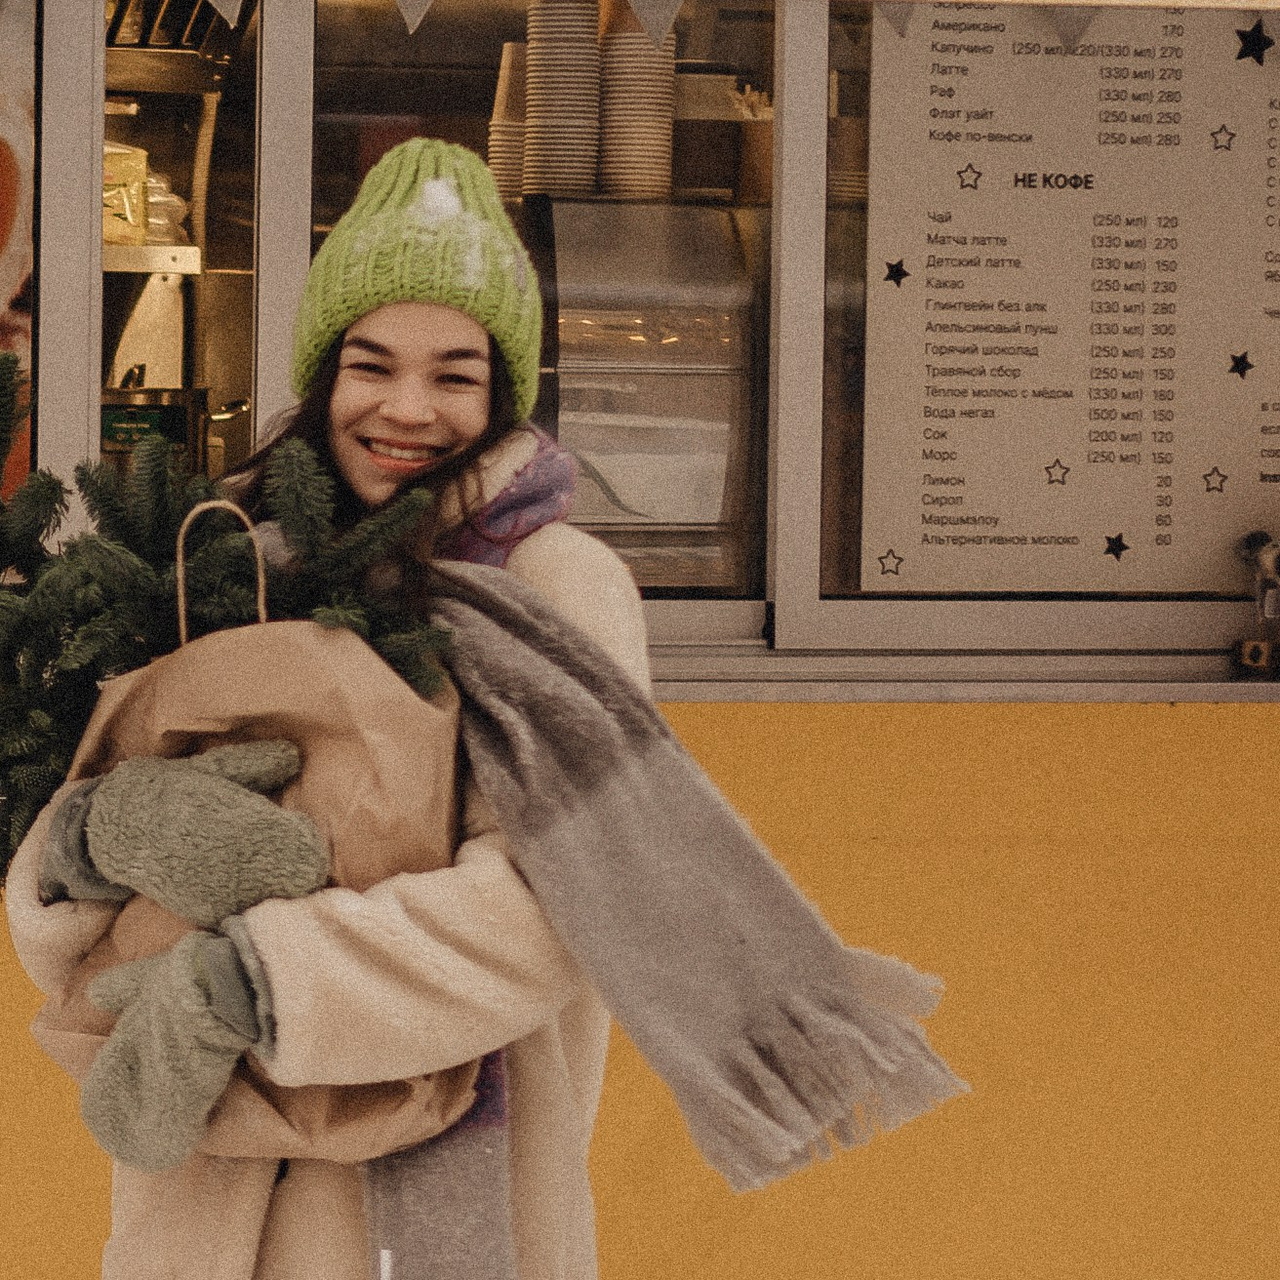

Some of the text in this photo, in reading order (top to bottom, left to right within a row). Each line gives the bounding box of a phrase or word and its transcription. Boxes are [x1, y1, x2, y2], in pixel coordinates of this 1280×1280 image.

[932, 20, 1184, 37] Американо 170
[931, 42, 994, 55] Капучино
[1012, 42, 1041, 55] (250
[1160, 46, 1183, 59] 270
[931, 63, 969, 76] Латте
[1099, 67, 1130, 80] (330
[1159, 68, 1182, 81] 270
[930, 85, 955, 99] Раф
[1098, 89, 1128, 102] (330
[1158, 90, 1182, 103] 280
[966, 109, 994, 122] уайт
[1098, 110, 1127, 123] (250
[1157, 112, 1182, 124] 250
[929, 130, 962, 142] Кофе
[966, 133, 1033, 143] по-венски
[1098, 132, 1127, 145] (250
[1156, 134, 1181, 146] 280
[1014, 173, 1093, 189] НЕ КОФЕ
[928, 212, 952, 224] Чай
[1093, 214, 1122, 227] (250
[1157, 216, 1179, 229] 120
[927, 233, 967, 246] Матча
[971, 236, 1007, 246] латте
[1091, 235, 1121, 248] (330
[1154, 237, 1178, 250] 270
[926, 255, 981, 268] Детский
[985, 258, 1021, 268] латте
[1091, 257, 1121, 270] (330
[1155, 260, 1178, 272] 150
[926, 278, 964, 289] Какао
[1091, 279, 1121, 292] (250
[1152, 281, 1177, 294] 230
[926, 299, 994, 311] Глинтвейн
[997, 300, 1021, 312] без
[1090, 301, 1120, 314] (330
[1152, 302, 1176, 315] 280
[925, 322, 1021, 334] Апельсиновый
[1025, 324, 1058, 336] пунш
[1090, 323, 1119, 335] (330
[1152, 324, 1175, 336] 300
[925, 343, 979, 356] Горячий
[982, 346, 1039, 357] шоколад
[1090, 345, 1119, 358] (250
[1151, 347, 1176, 359] 250
[925, 364, 986, 378] Травяной
[990, 365, 1021, 379] сбор
[1090, 367, 1118, 380] (250
[1153, 368, 1175, 381] 150
[972, 389, 1017, 398] молоко
[1020, 389, 1028, 399] с
[1032, 388, 1073, 399] мёдом
[1088, 388, 1118, 400] (330
[924, 406, 956, 419] Вода
[960, 409, 995, 418] негаз
[1088, 408, 1118, 421] (500
[1152, 409, 1175, 422] 150
[923, 428, 947, 440] Сок
[1088, 430, 1117, 442] (200
[1152, 431, 1174, 443] 120
[922, 449, 957, 462] Морс
[1087, 451, 1116, 464] (250
[1152, 452, 1173, 465] 150
[923, 474, 1172, 488] Лимон 20
[921, 493, 1173, 507] Сироп 30
[922, 533, 1027, 546] Альтернативное
[1031, 536, 1079, 545] молоко
